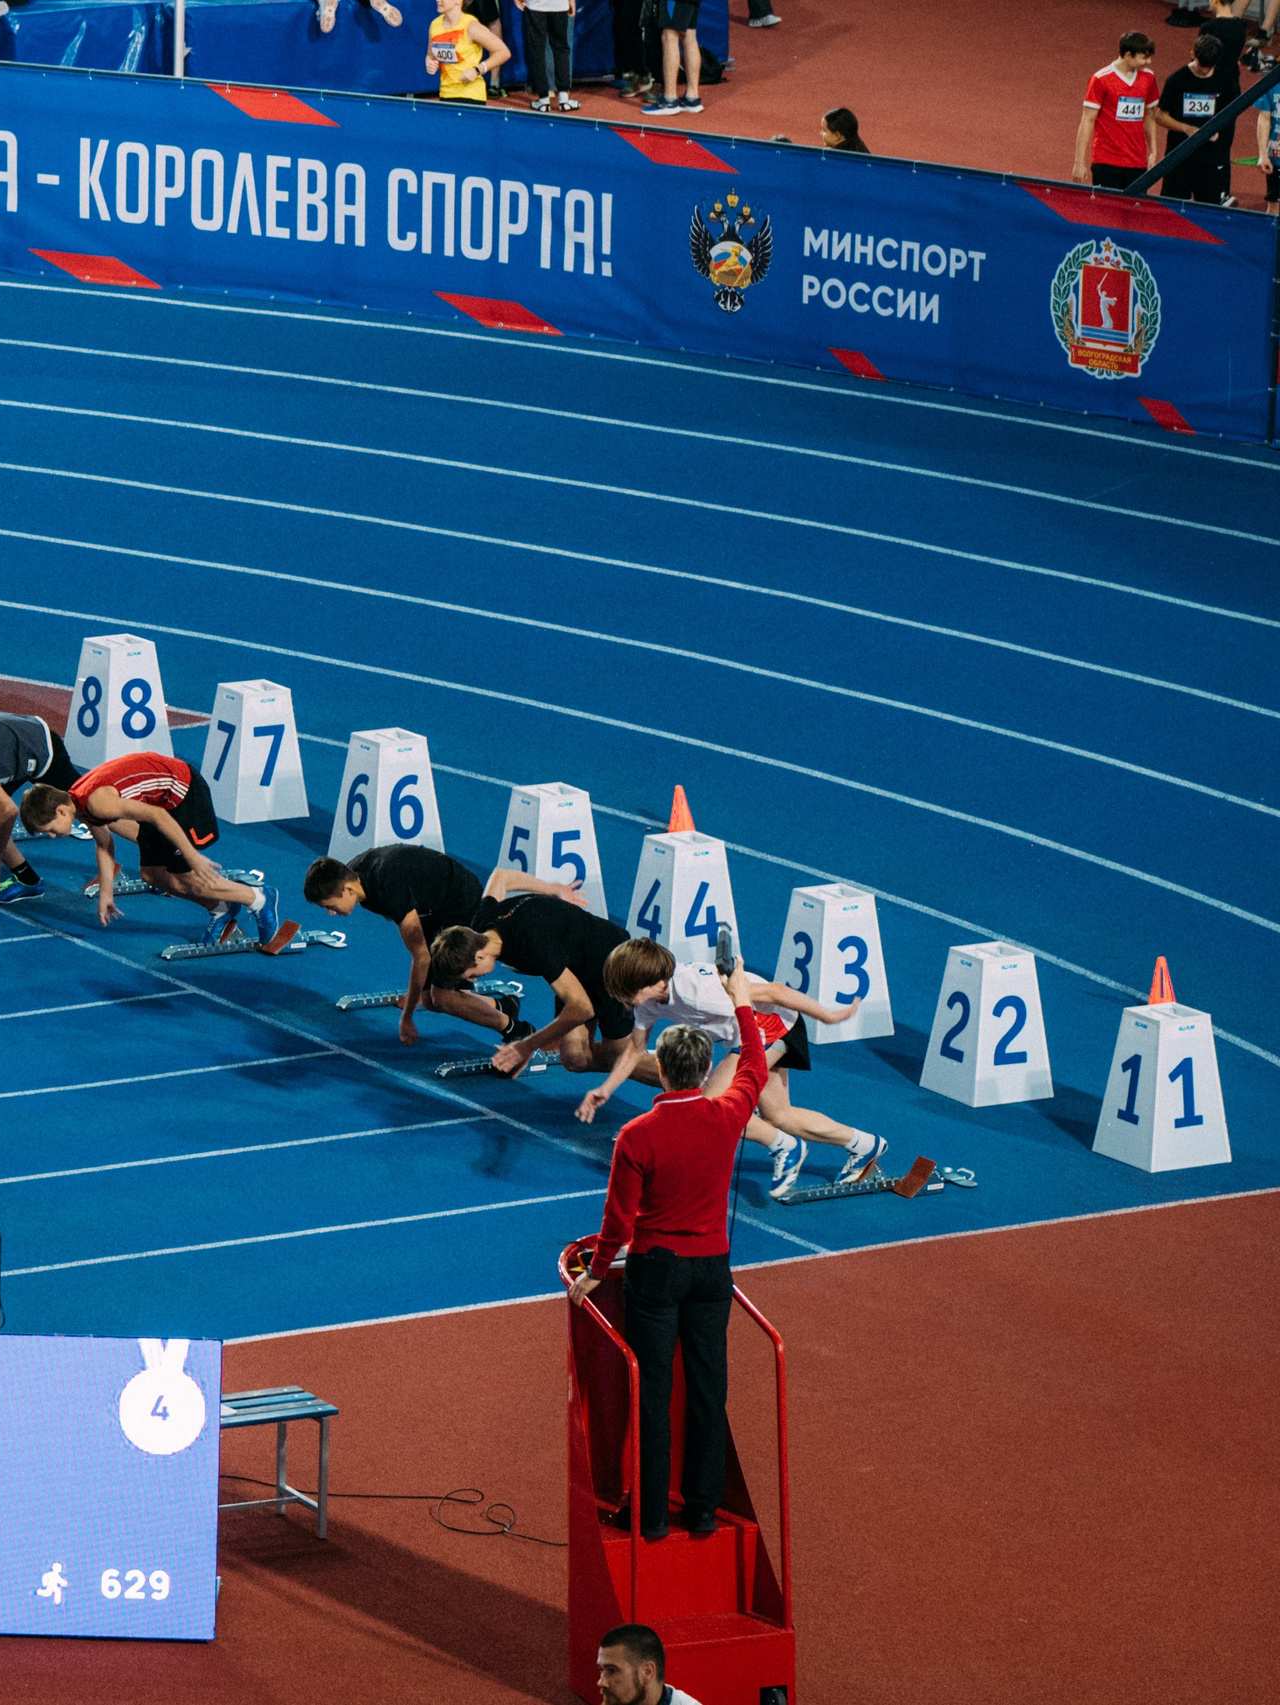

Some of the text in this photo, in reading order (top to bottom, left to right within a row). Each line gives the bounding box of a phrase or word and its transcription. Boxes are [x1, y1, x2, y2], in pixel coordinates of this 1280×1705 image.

[437, 50, 453, 60] 400
[1122, 104, 1141, 115] 441
[1188, 101, 1210, 112] 236
[79, 137, 366, 247] КОРОЛЕВА
[387, 168, 613, 277] СПОРТА!
[803, 226, 986, 282] МИНСПОРТ
[802, 274, 939, 324] РОССИИ
[77, 676, 102, 737] 8
[121, 678, 156, 739] 8
[213, 720, 236, 782] 7
[253, 724, 285, 787] 7
[346, 773, 370, 837] 6
[389, 774, 424, 840] 6
[508, 825, 530, 873] 5
[551, 830, 586, 890] 5
[637, 878, 662, 942] 4
[685, 881, 719, 947] 4
[785, 931, 813, 994] 3
[835, 935, 870, 1005] 3
[940, 991, 971, 1063] 2
[992, 995, 1027, 1066] 2
[1117, 1053, 1142, 1125] 1
[1168, 1057, 1203, 1129] 1
[151, 1395, 169, 1421] 4
[101, 1568, 170, 1600] 629
